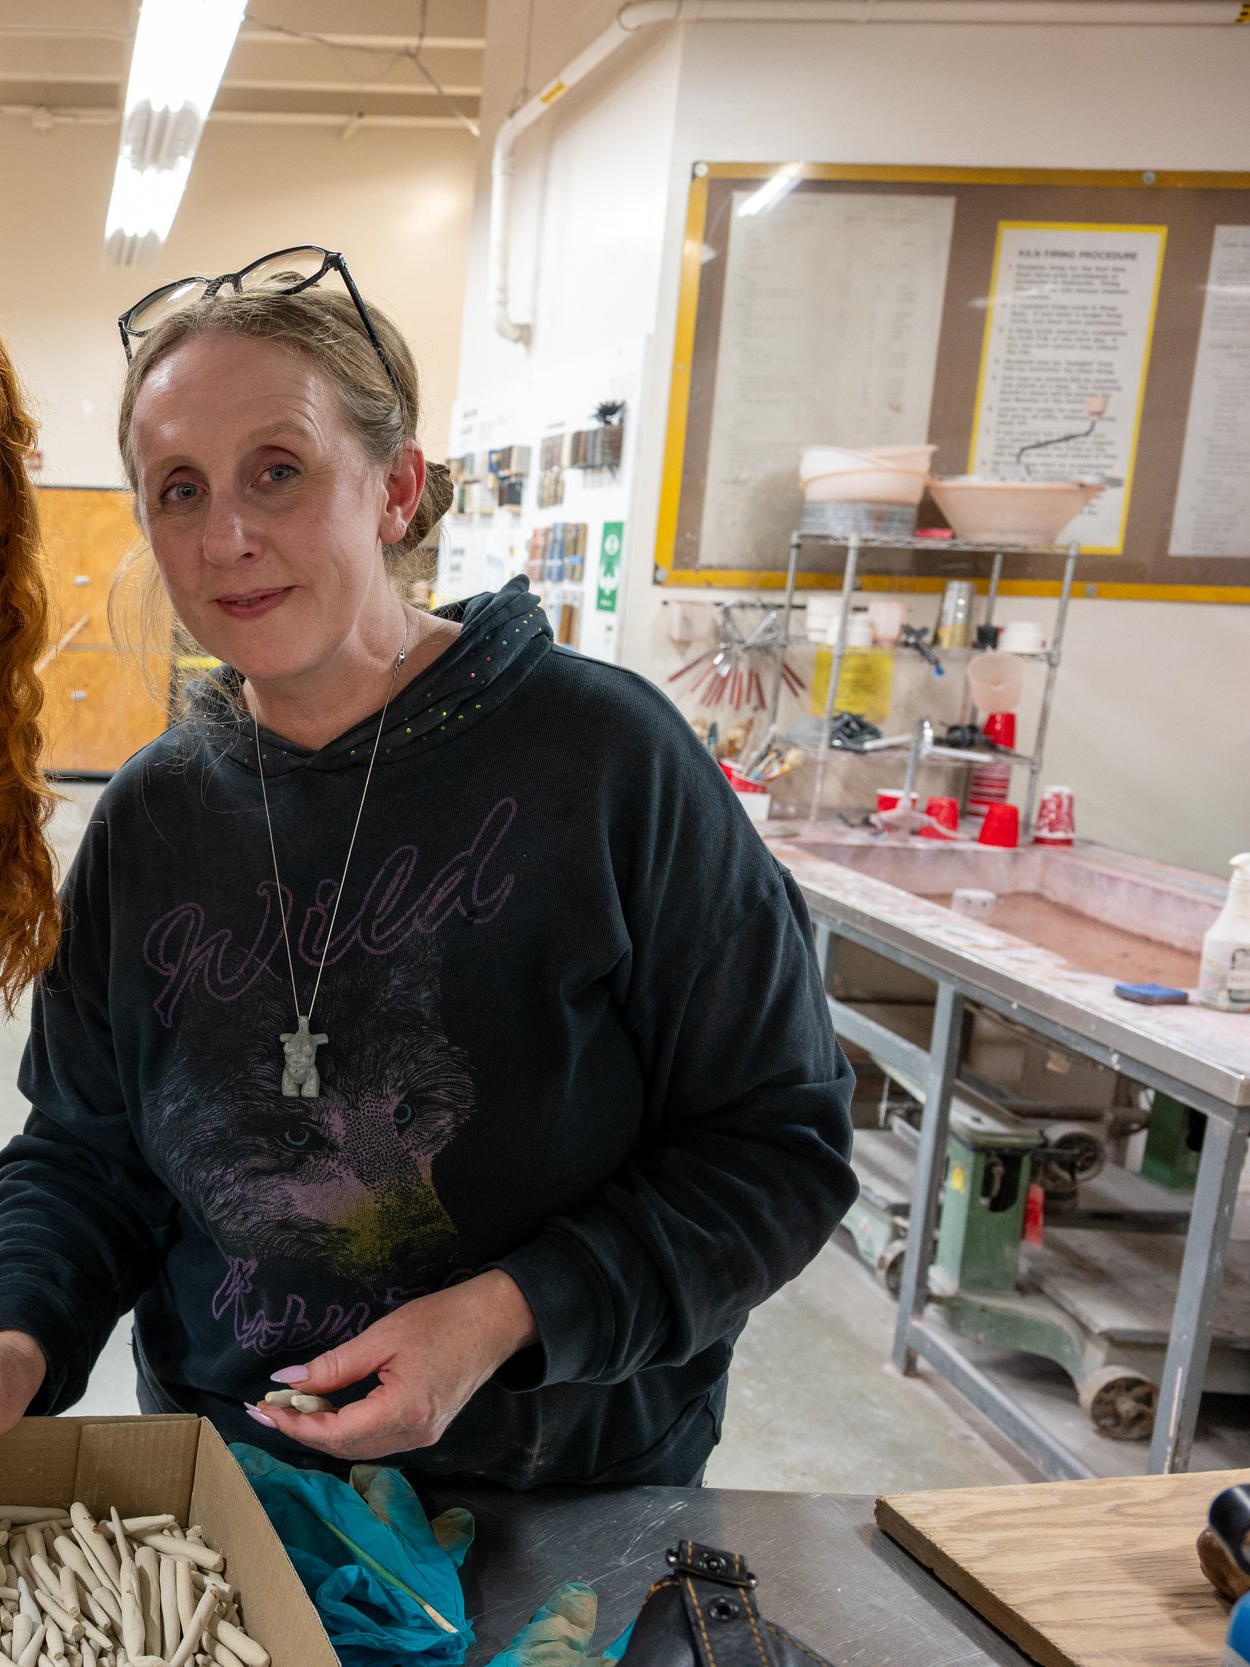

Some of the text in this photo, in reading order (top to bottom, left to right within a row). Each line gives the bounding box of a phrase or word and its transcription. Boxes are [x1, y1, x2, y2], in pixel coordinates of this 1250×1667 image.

[1044, 250, 1075, 259] FIRING
[1079, 251, 1138, 261] PROCEDURE
[142, 797, 518, 1028] Wild
